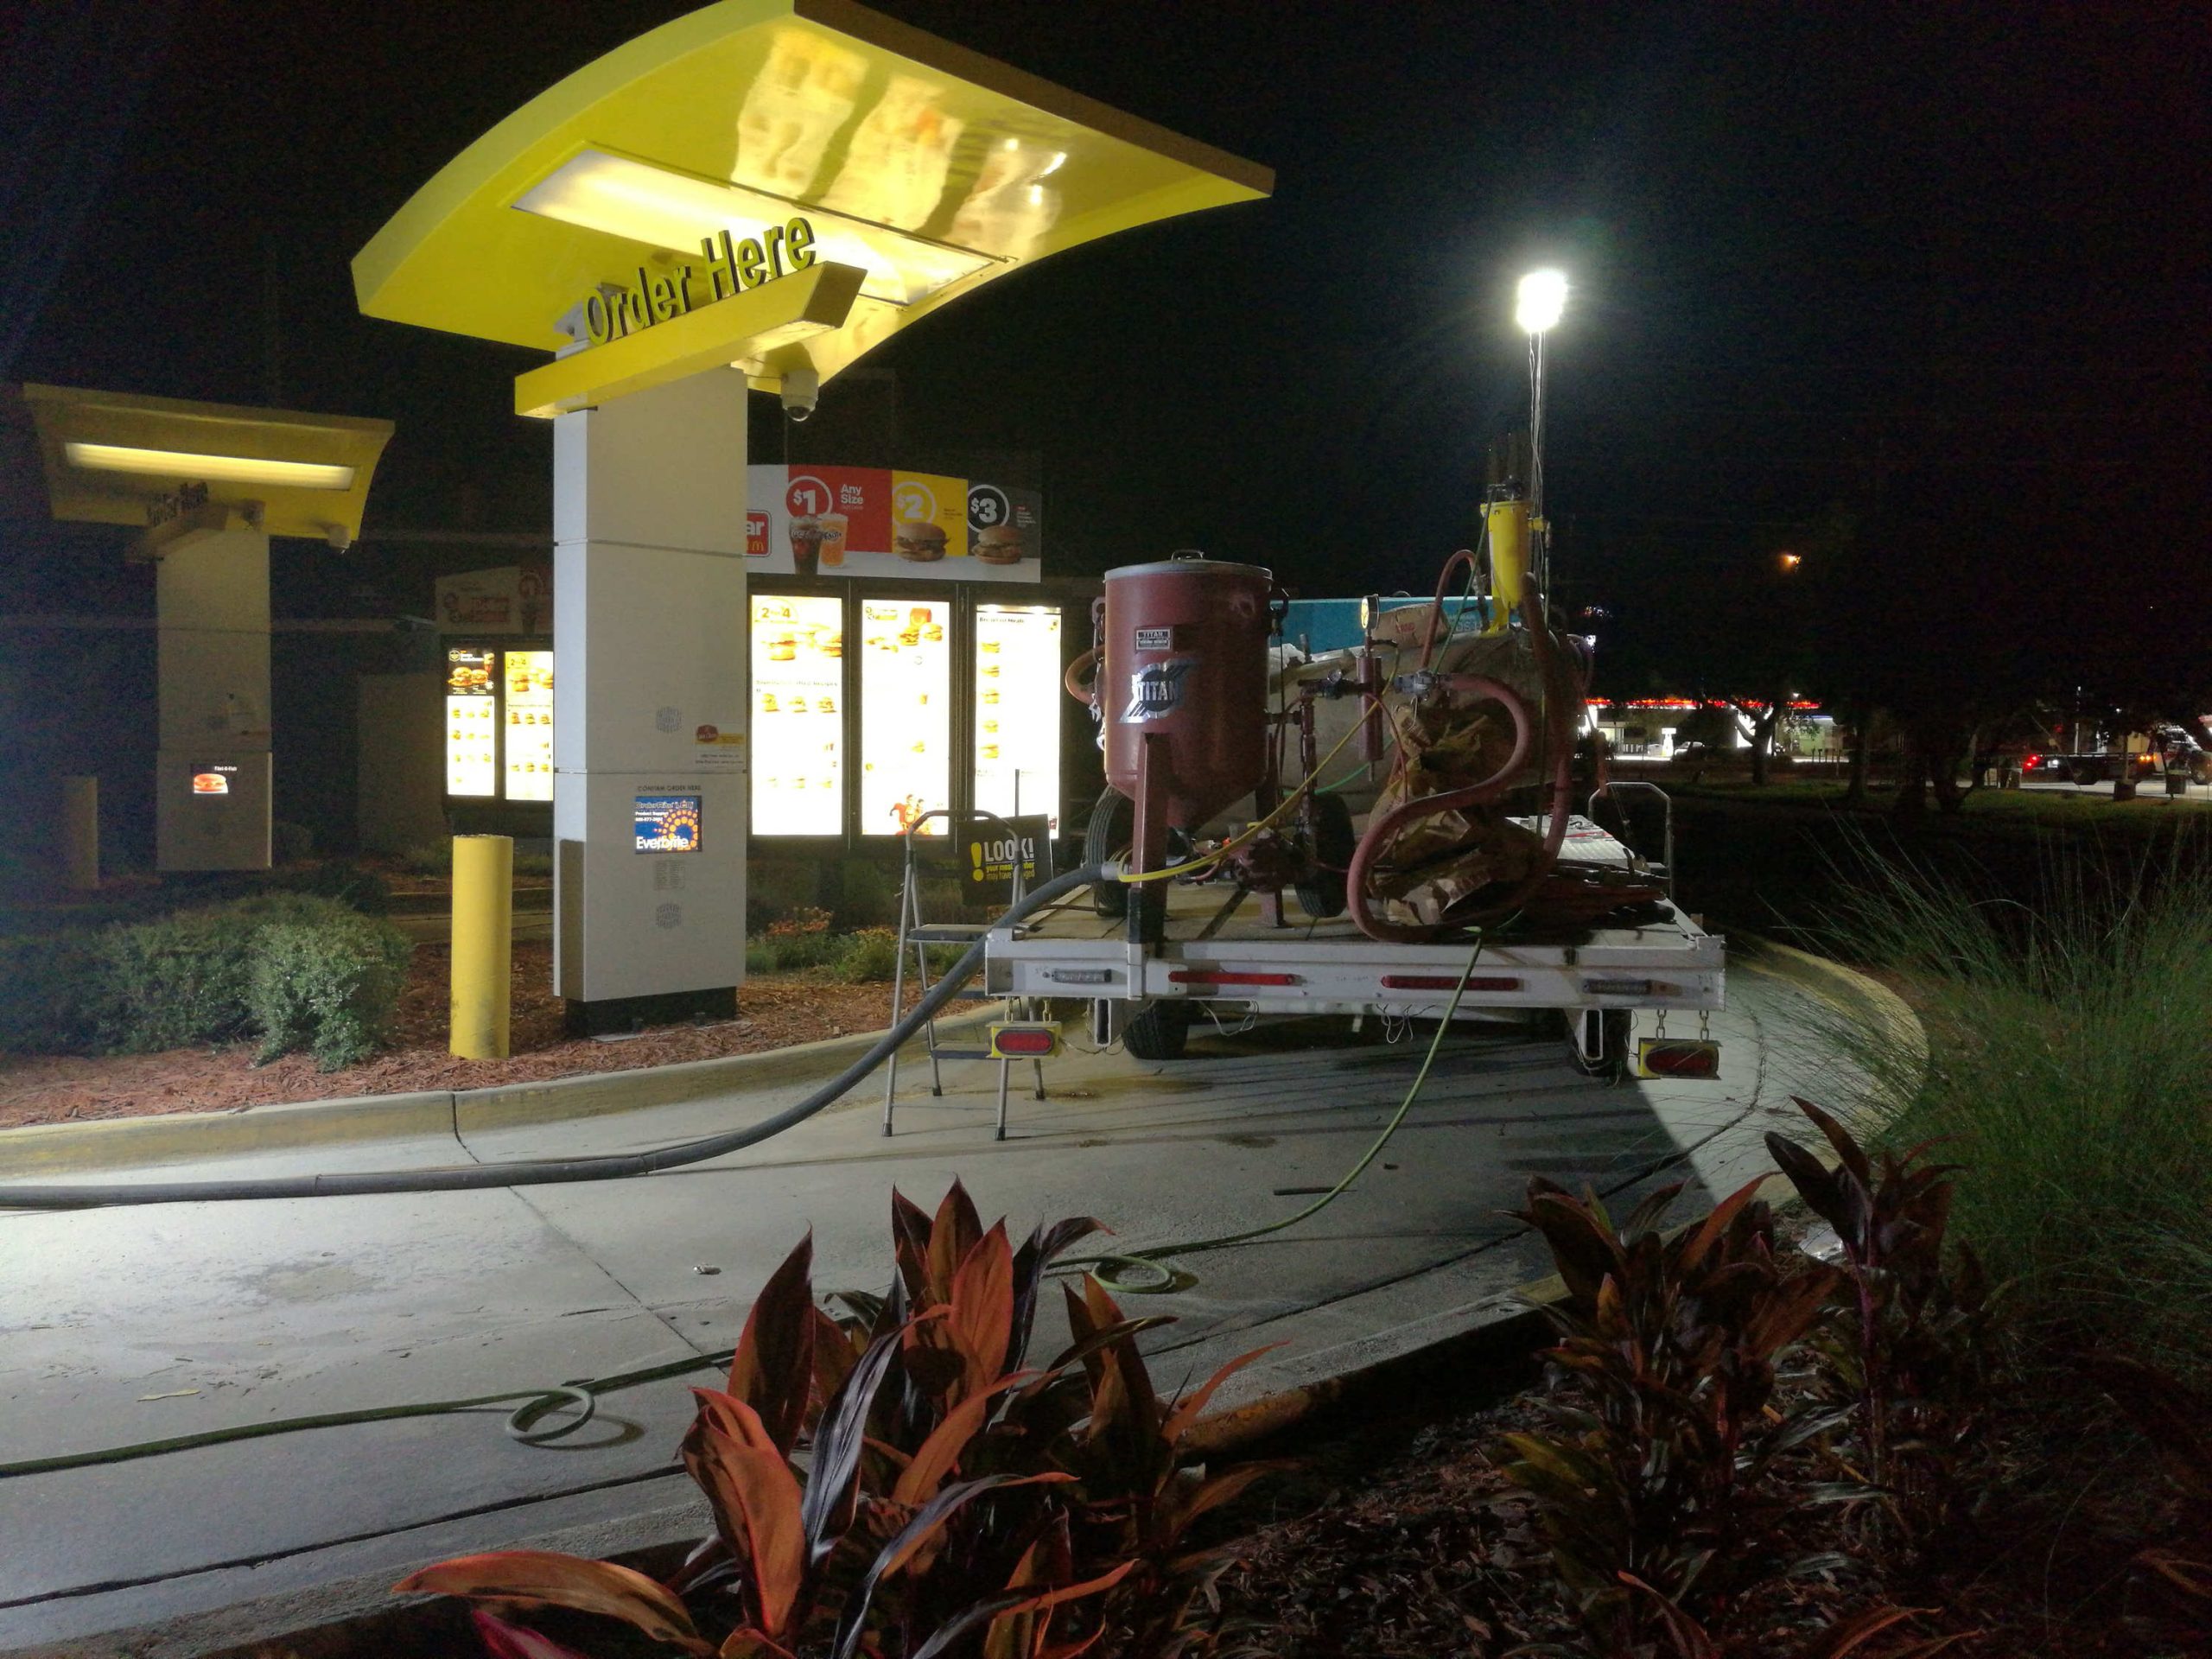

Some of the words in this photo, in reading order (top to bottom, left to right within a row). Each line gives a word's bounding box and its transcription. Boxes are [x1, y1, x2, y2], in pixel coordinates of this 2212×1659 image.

[583, 267, 692, 346] Order
[701, 217, 817, 302] Here
[793, 489, 817, 514] $1
[841, 484, 862, 495] Any
[841, 493, 864, 505] Size
[896, 494, 924, 518] $2
[970, 498, 998, 524] $3
[636, 835, 690, 850] Everbrite
[983, 837, 1035, 862] LOOK!
